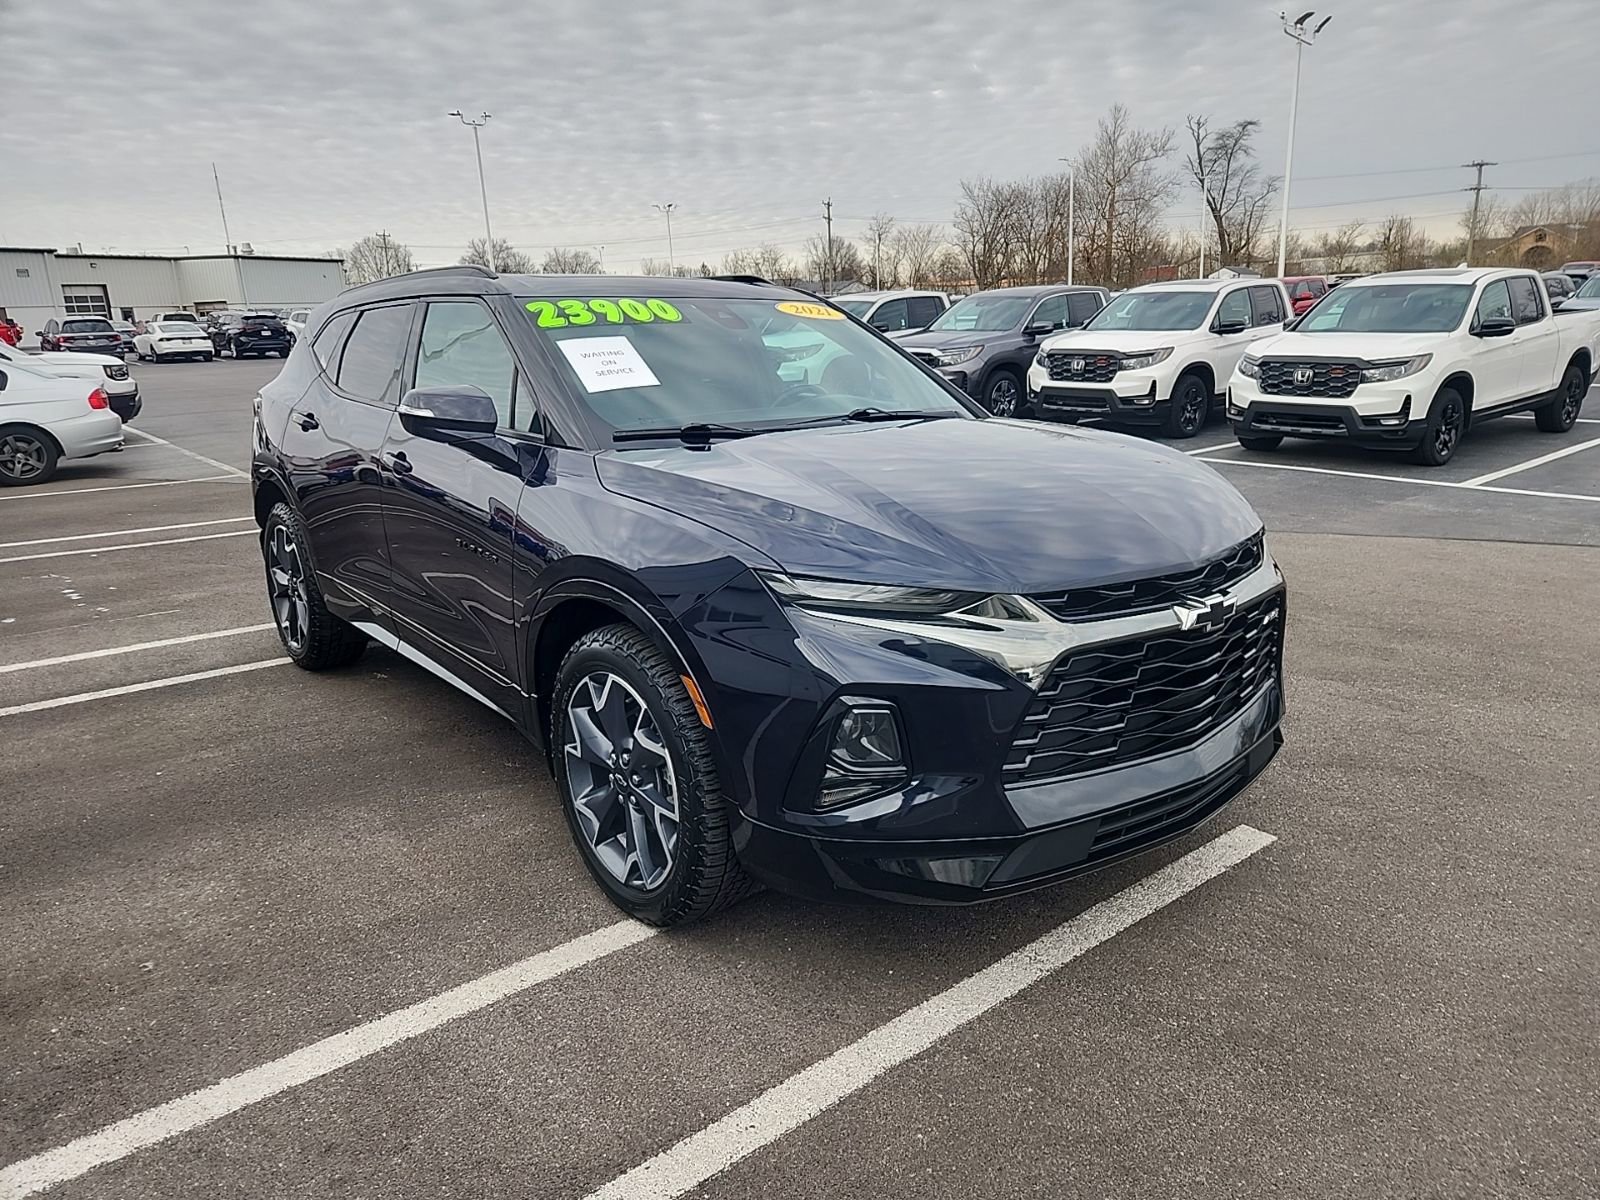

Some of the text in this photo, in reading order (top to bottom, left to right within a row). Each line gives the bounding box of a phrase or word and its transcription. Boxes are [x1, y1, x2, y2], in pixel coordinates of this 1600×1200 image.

[525, 299, 683, 329] 23900
[789, 304, 831, 316] 2021
[580, 350, 625, 359] WAITING
[595, 367, 635, 376] SERVICE
